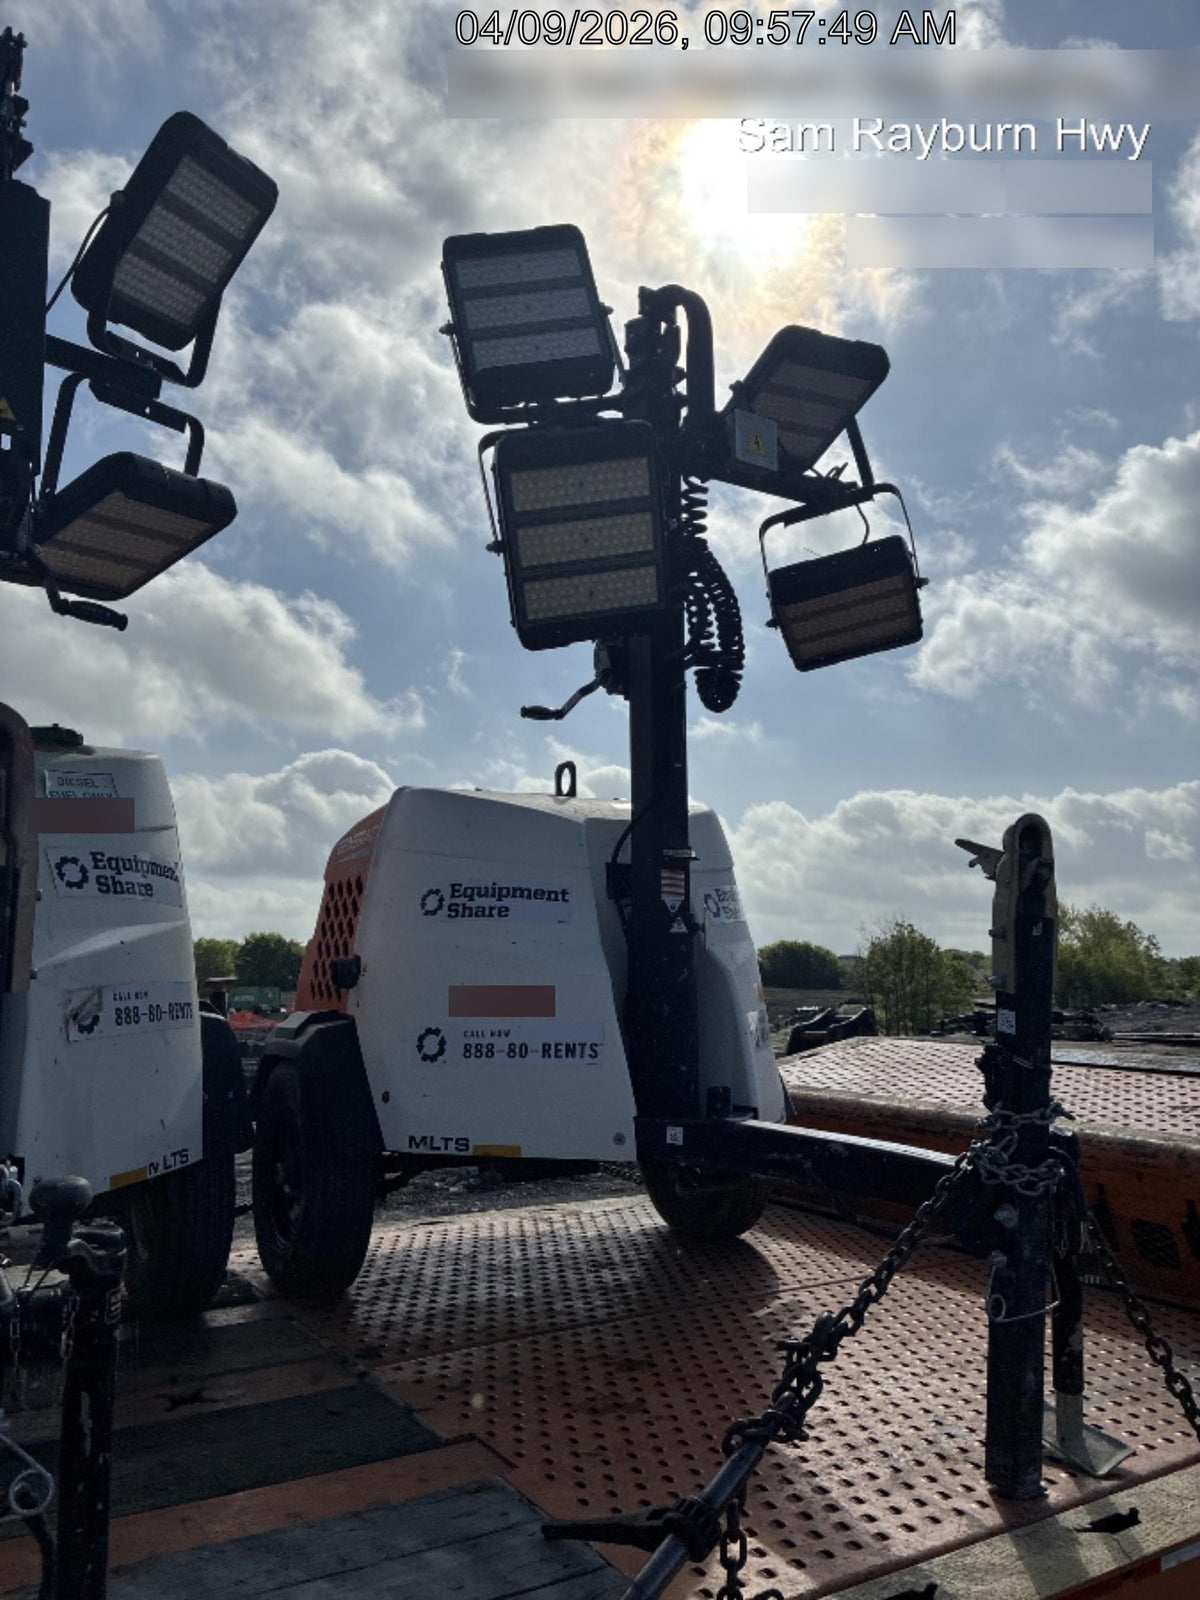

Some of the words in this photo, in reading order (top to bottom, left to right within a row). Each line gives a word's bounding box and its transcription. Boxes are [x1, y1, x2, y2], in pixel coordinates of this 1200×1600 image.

[95, 874, 154, 897] Share
[449, 882, 570, 904] Equipment
[447, 902, 510, 919] Share
[463, 1030, 485, 1038] CALL
[490, 1029, 511, 1038] NOW
[463, 1042, 599, 1060] 888-80-RENTS
[408, 1136, 470, 1152] MLTS
